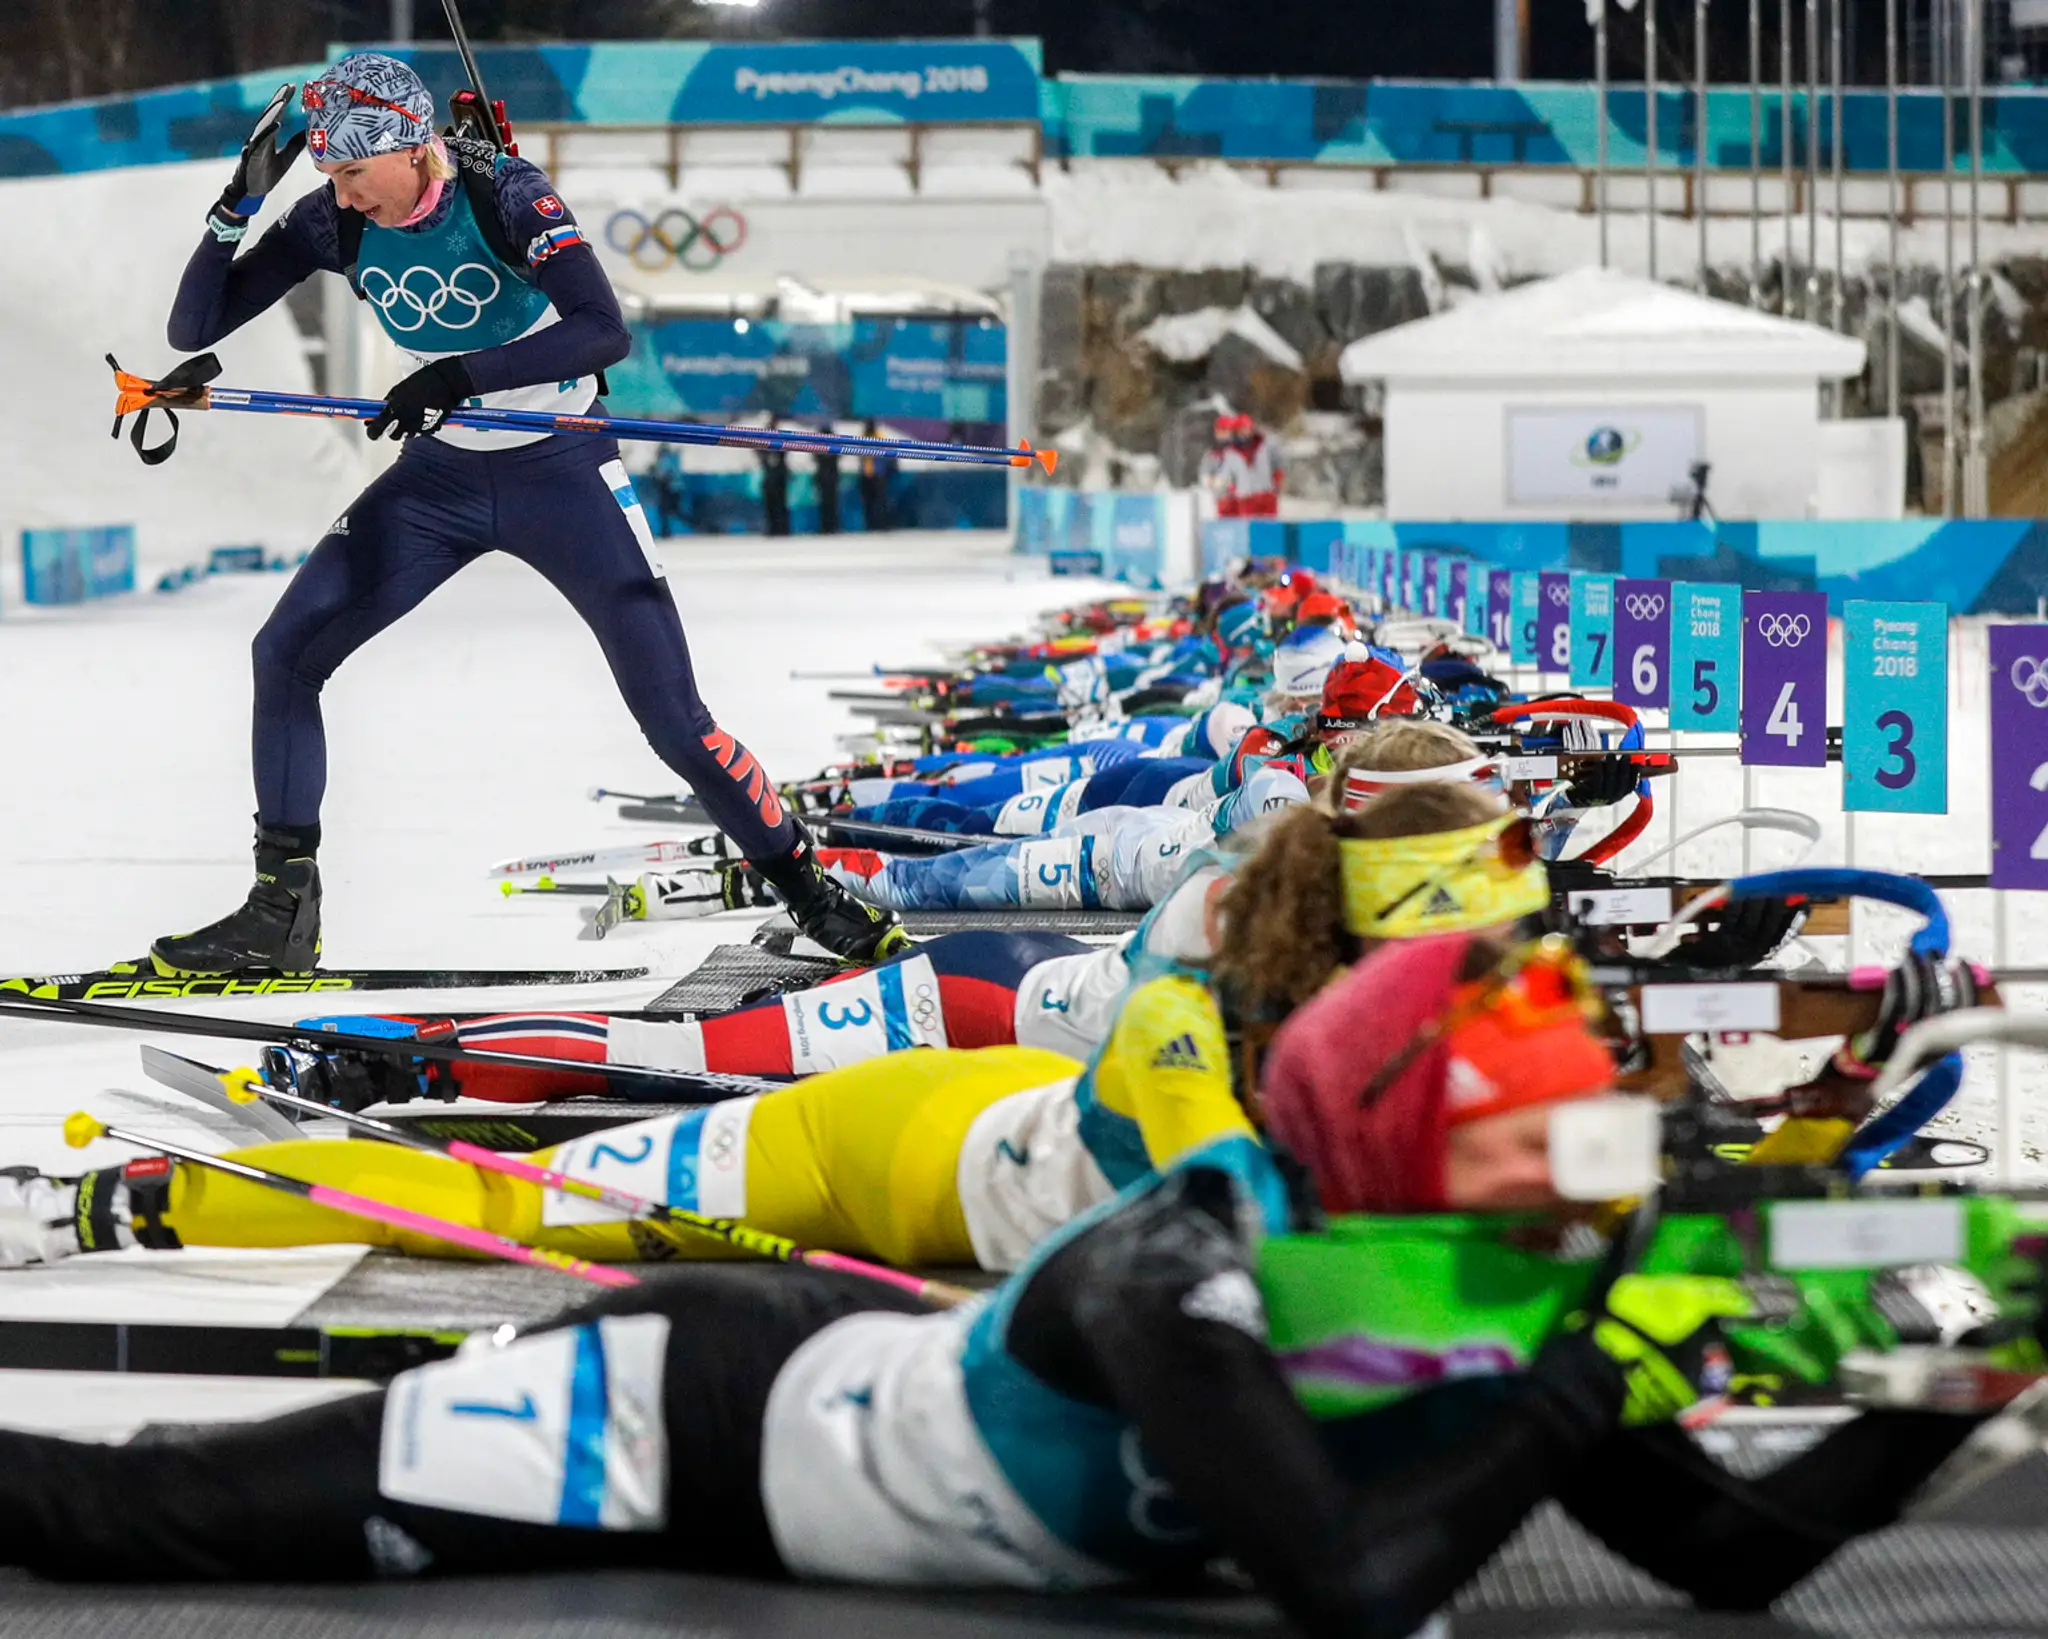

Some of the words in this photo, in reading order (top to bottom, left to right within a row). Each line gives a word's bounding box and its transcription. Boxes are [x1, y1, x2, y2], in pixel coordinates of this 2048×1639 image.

[734, 66, 922, 100] PyeongChang
[925, 65, 989, 94] 2018
[1690, 607, 1721, 621] Chang
[1873, 618, 1919, 636] Pyeong
[1523, 620, 1538, 654] 9
[1690, 621, 1721, 637] 2018
[1551, 622, 1570, 666] 8
[1586, 632, 1608, 675] 7
[1872, 636, 1919, 654] Chang
[1631, 644, 1658, 696] 6
[1872, 656, 1920, 678] 2018
[1692, 660, 1719, 716] 5
[1324, 718, 1356, 729] Julbo
[1765, 681, 1804, 748] 4
[1874, 710, 1917, 790] 3
[1017, 795, 1044, 812] 6
[1159, 843, 1181, 858] 5
[1039, 863, 1073, 887] 5
[817, 997, 873, 1031] 3
[1042, 987, 1070, 1014] 3
[799, 1035, 811, 1059] 2018
[589, 1135, 654, 1170] 2
[995, 1138, 1028, 1166] 2
[450, 1388, 538, 1422] 1
